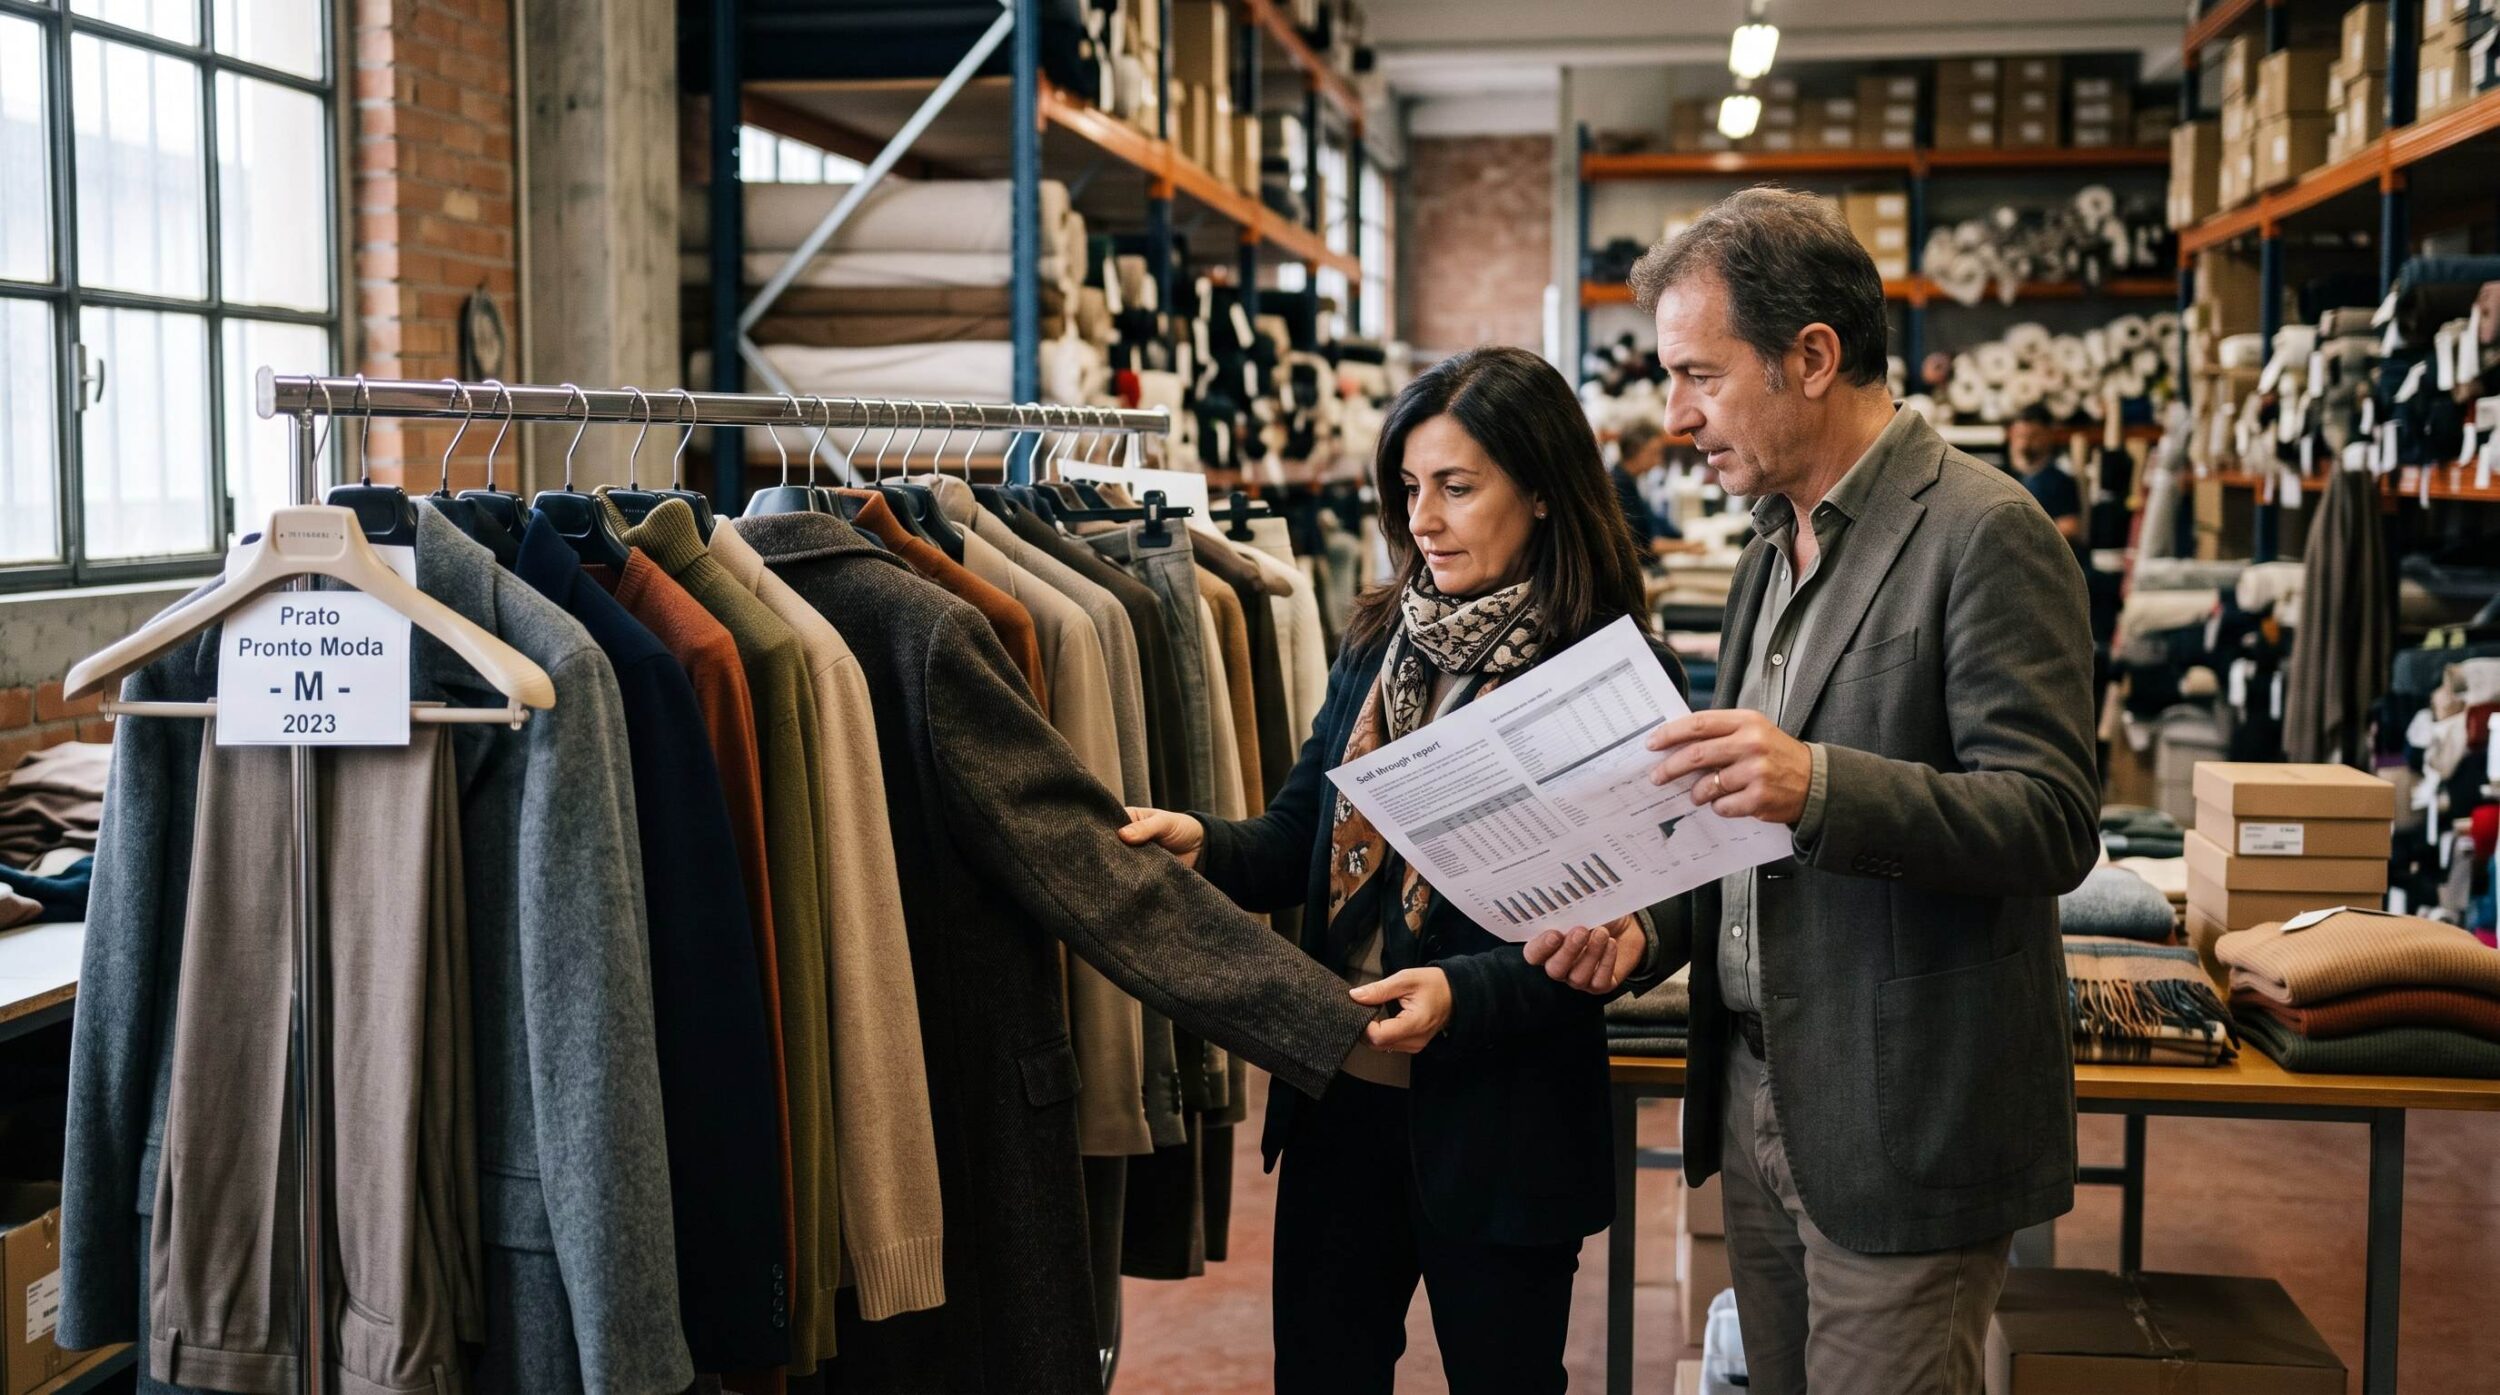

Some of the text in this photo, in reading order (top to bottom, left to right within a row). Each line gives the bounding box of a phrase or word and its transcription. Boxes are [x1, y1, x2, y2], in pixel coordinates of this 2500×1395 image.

[280, 606, 340, 625] Prato
[239, 637, 384, 657] Pronto Moda
[294, 671, 323, 701] M
[282, 714, 337, 733] 2023
[1356, 741, 1441, 784] Sell through report
